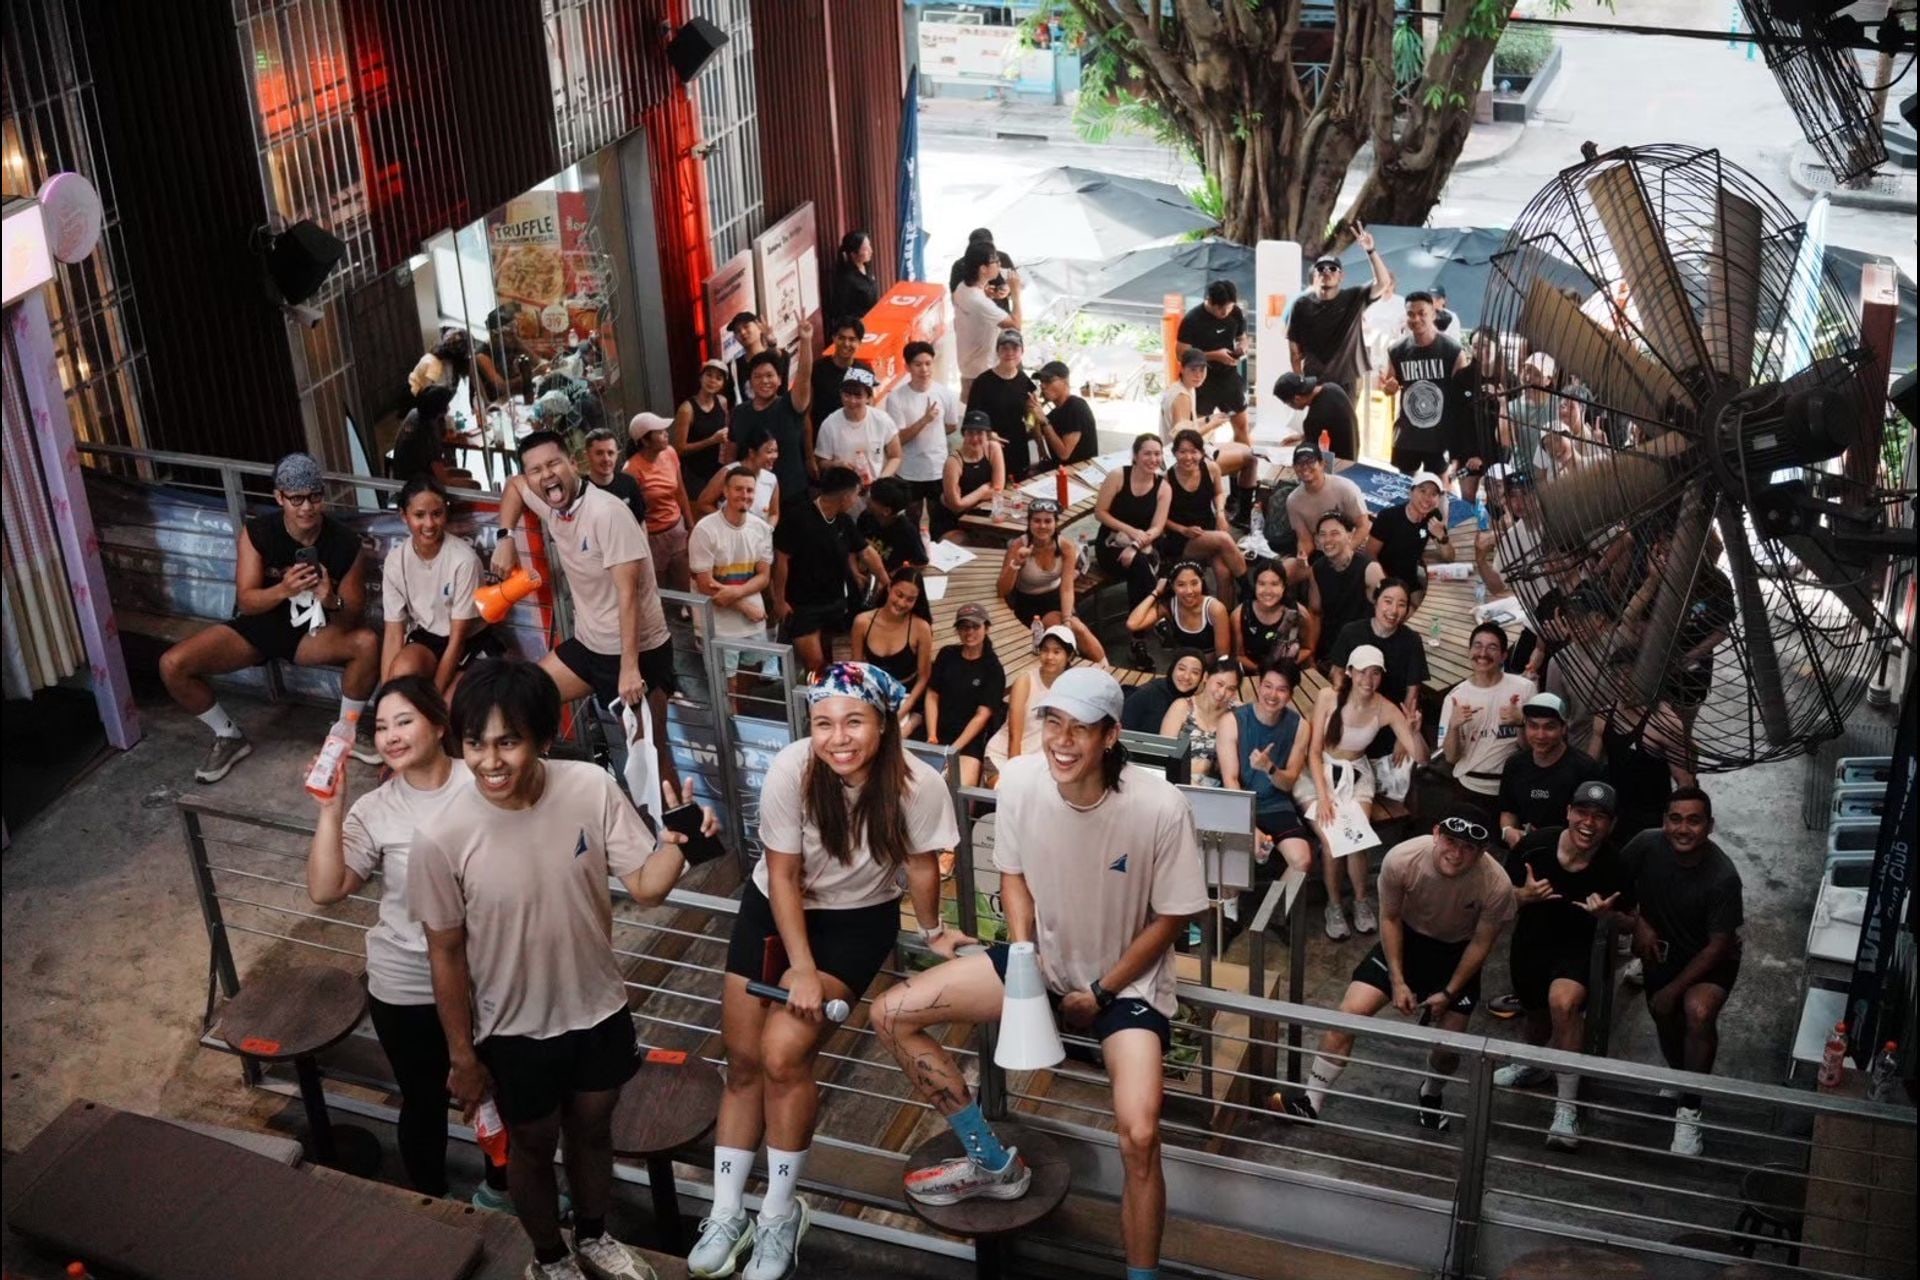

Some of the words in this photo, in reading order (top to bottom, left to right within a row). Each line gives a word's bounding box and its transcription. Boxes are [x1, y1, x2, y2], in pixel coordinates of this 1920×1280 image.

[495, 216, 553, 238] TRUFFLE
[1400, 358, 1445, 381] NIRVANA
[1888, 840, 1909, 882] Club
